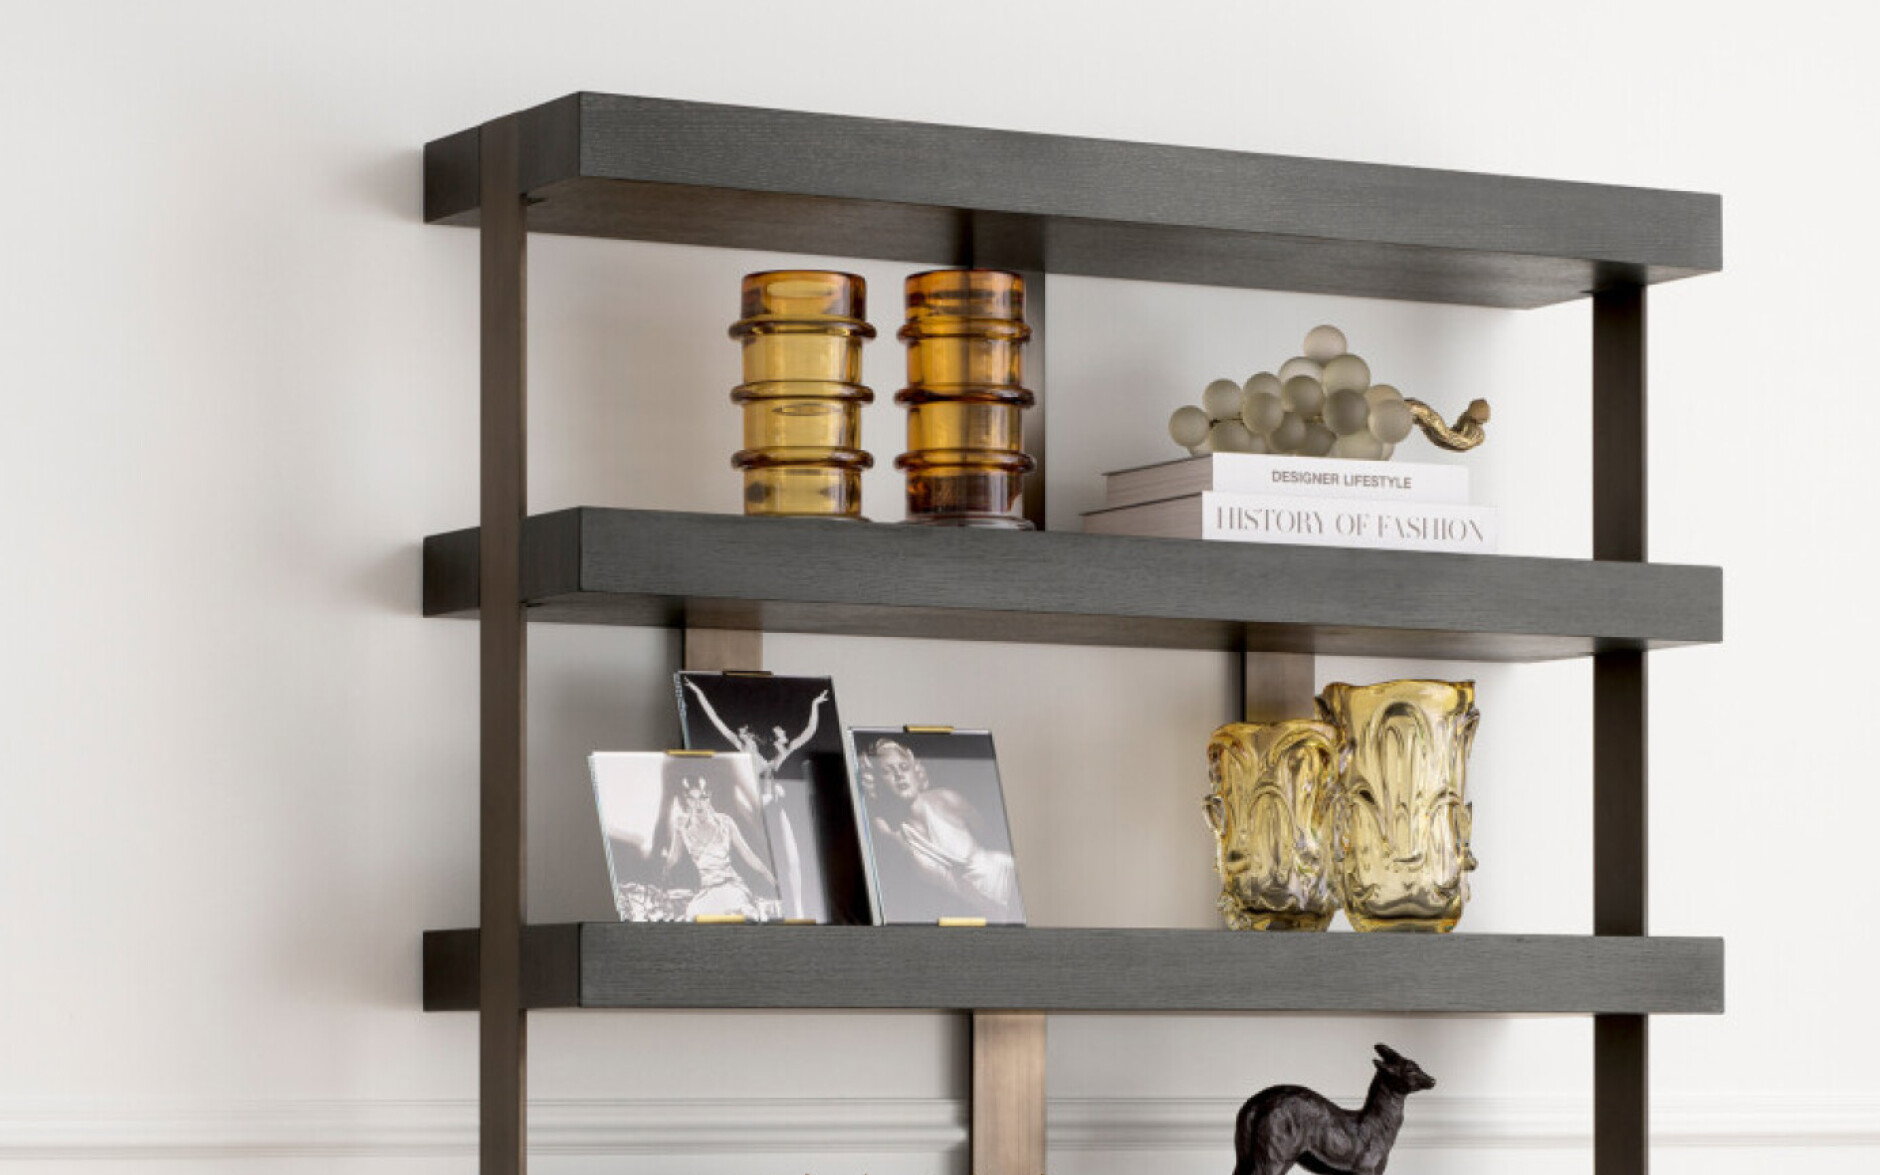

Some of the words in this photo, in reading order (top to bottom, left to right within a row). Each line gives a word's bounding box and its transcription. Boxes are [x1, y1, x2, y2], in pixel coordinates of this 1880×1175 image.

[1271, 470, 1340, 485] DESIGNER
[1344, 475, 1413, 489] LIFESTYLE
[1217, 506, 1324, 534] HISTORY
[1336, 513, 1369, 536] OF
[1378, 515, 1484, 542] FASHION
